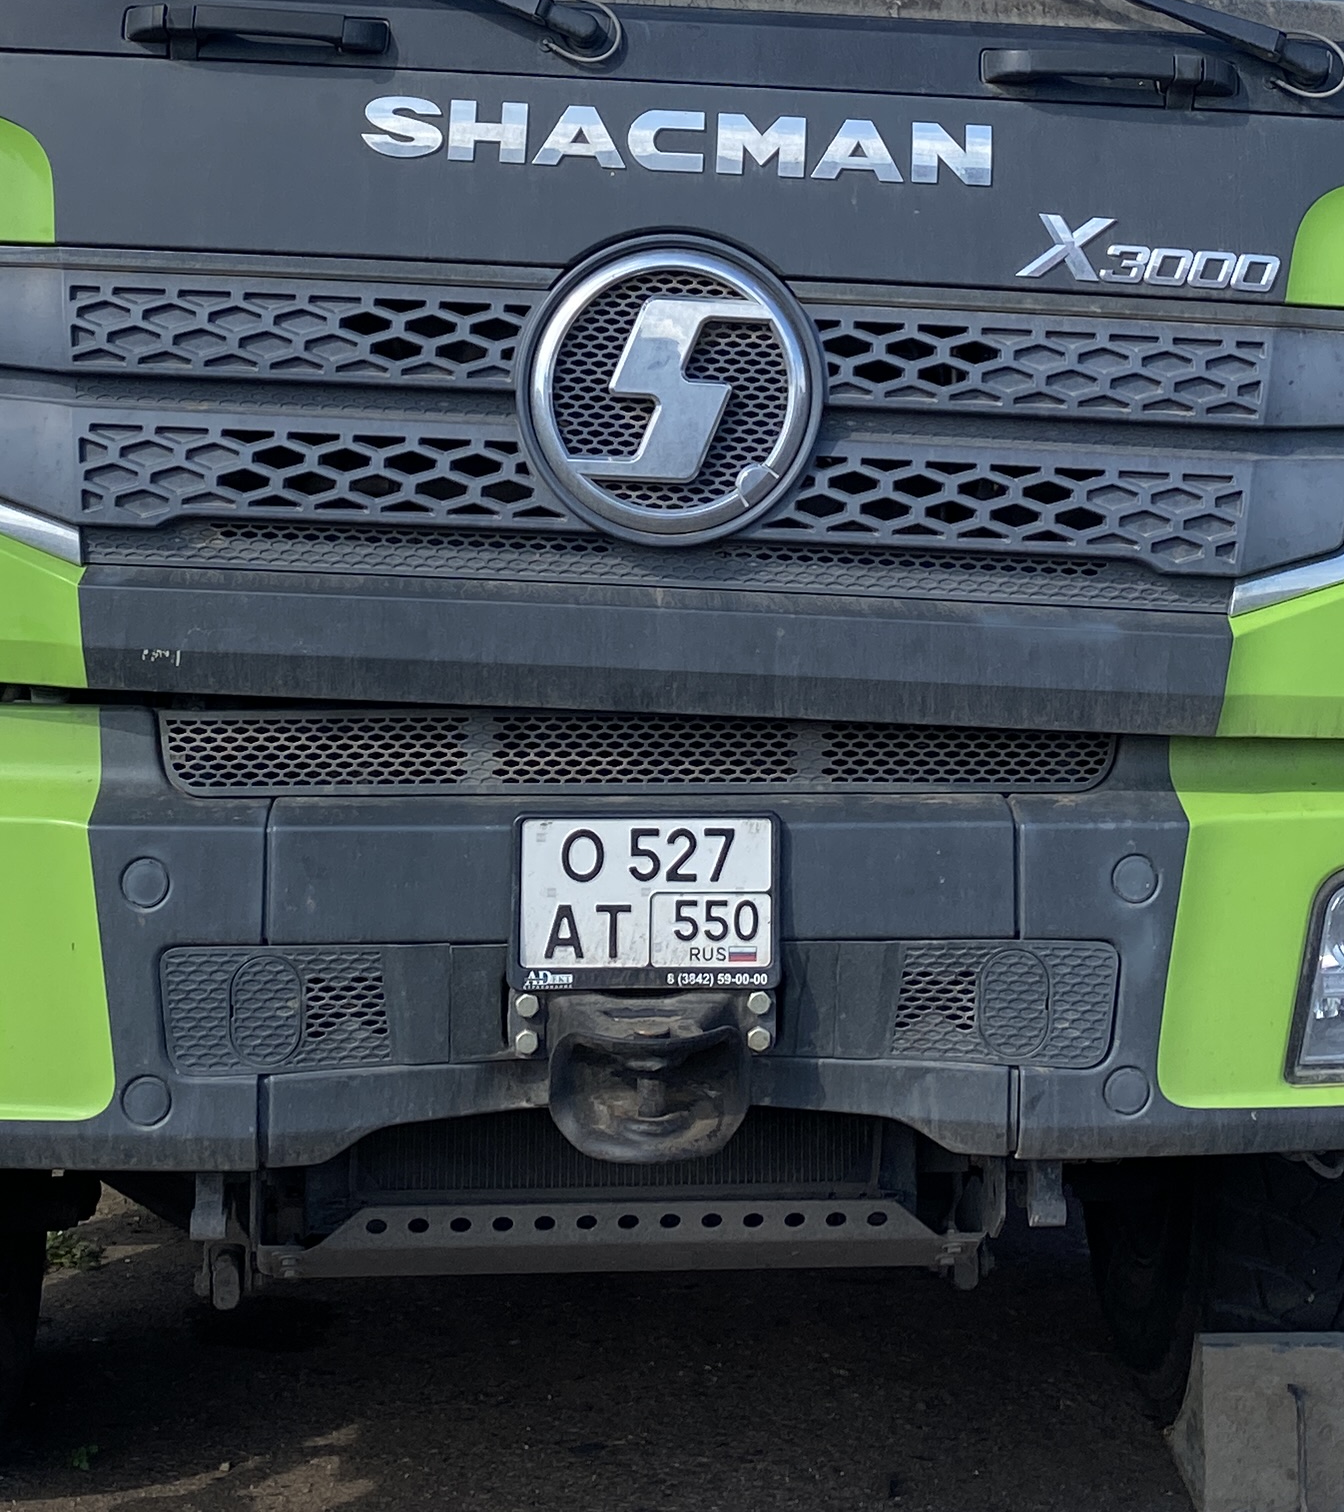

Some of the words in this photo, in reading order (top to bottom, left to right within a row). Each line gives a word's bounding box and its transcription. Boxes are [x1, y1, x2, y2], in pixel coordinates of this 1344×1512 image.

[360, 95, 993, 187] SHACMAN
[1015, 212, 1281, 293] X3000
[628, 827, 735, 883] 527
[672, 899, 760, 942] 550
[689, 946, 727, 962] RUS
[666, 973, 675, 985] 8
[677, 973, 715, 988] (3842)
[717, 973, 768, 985] 59-00-00
